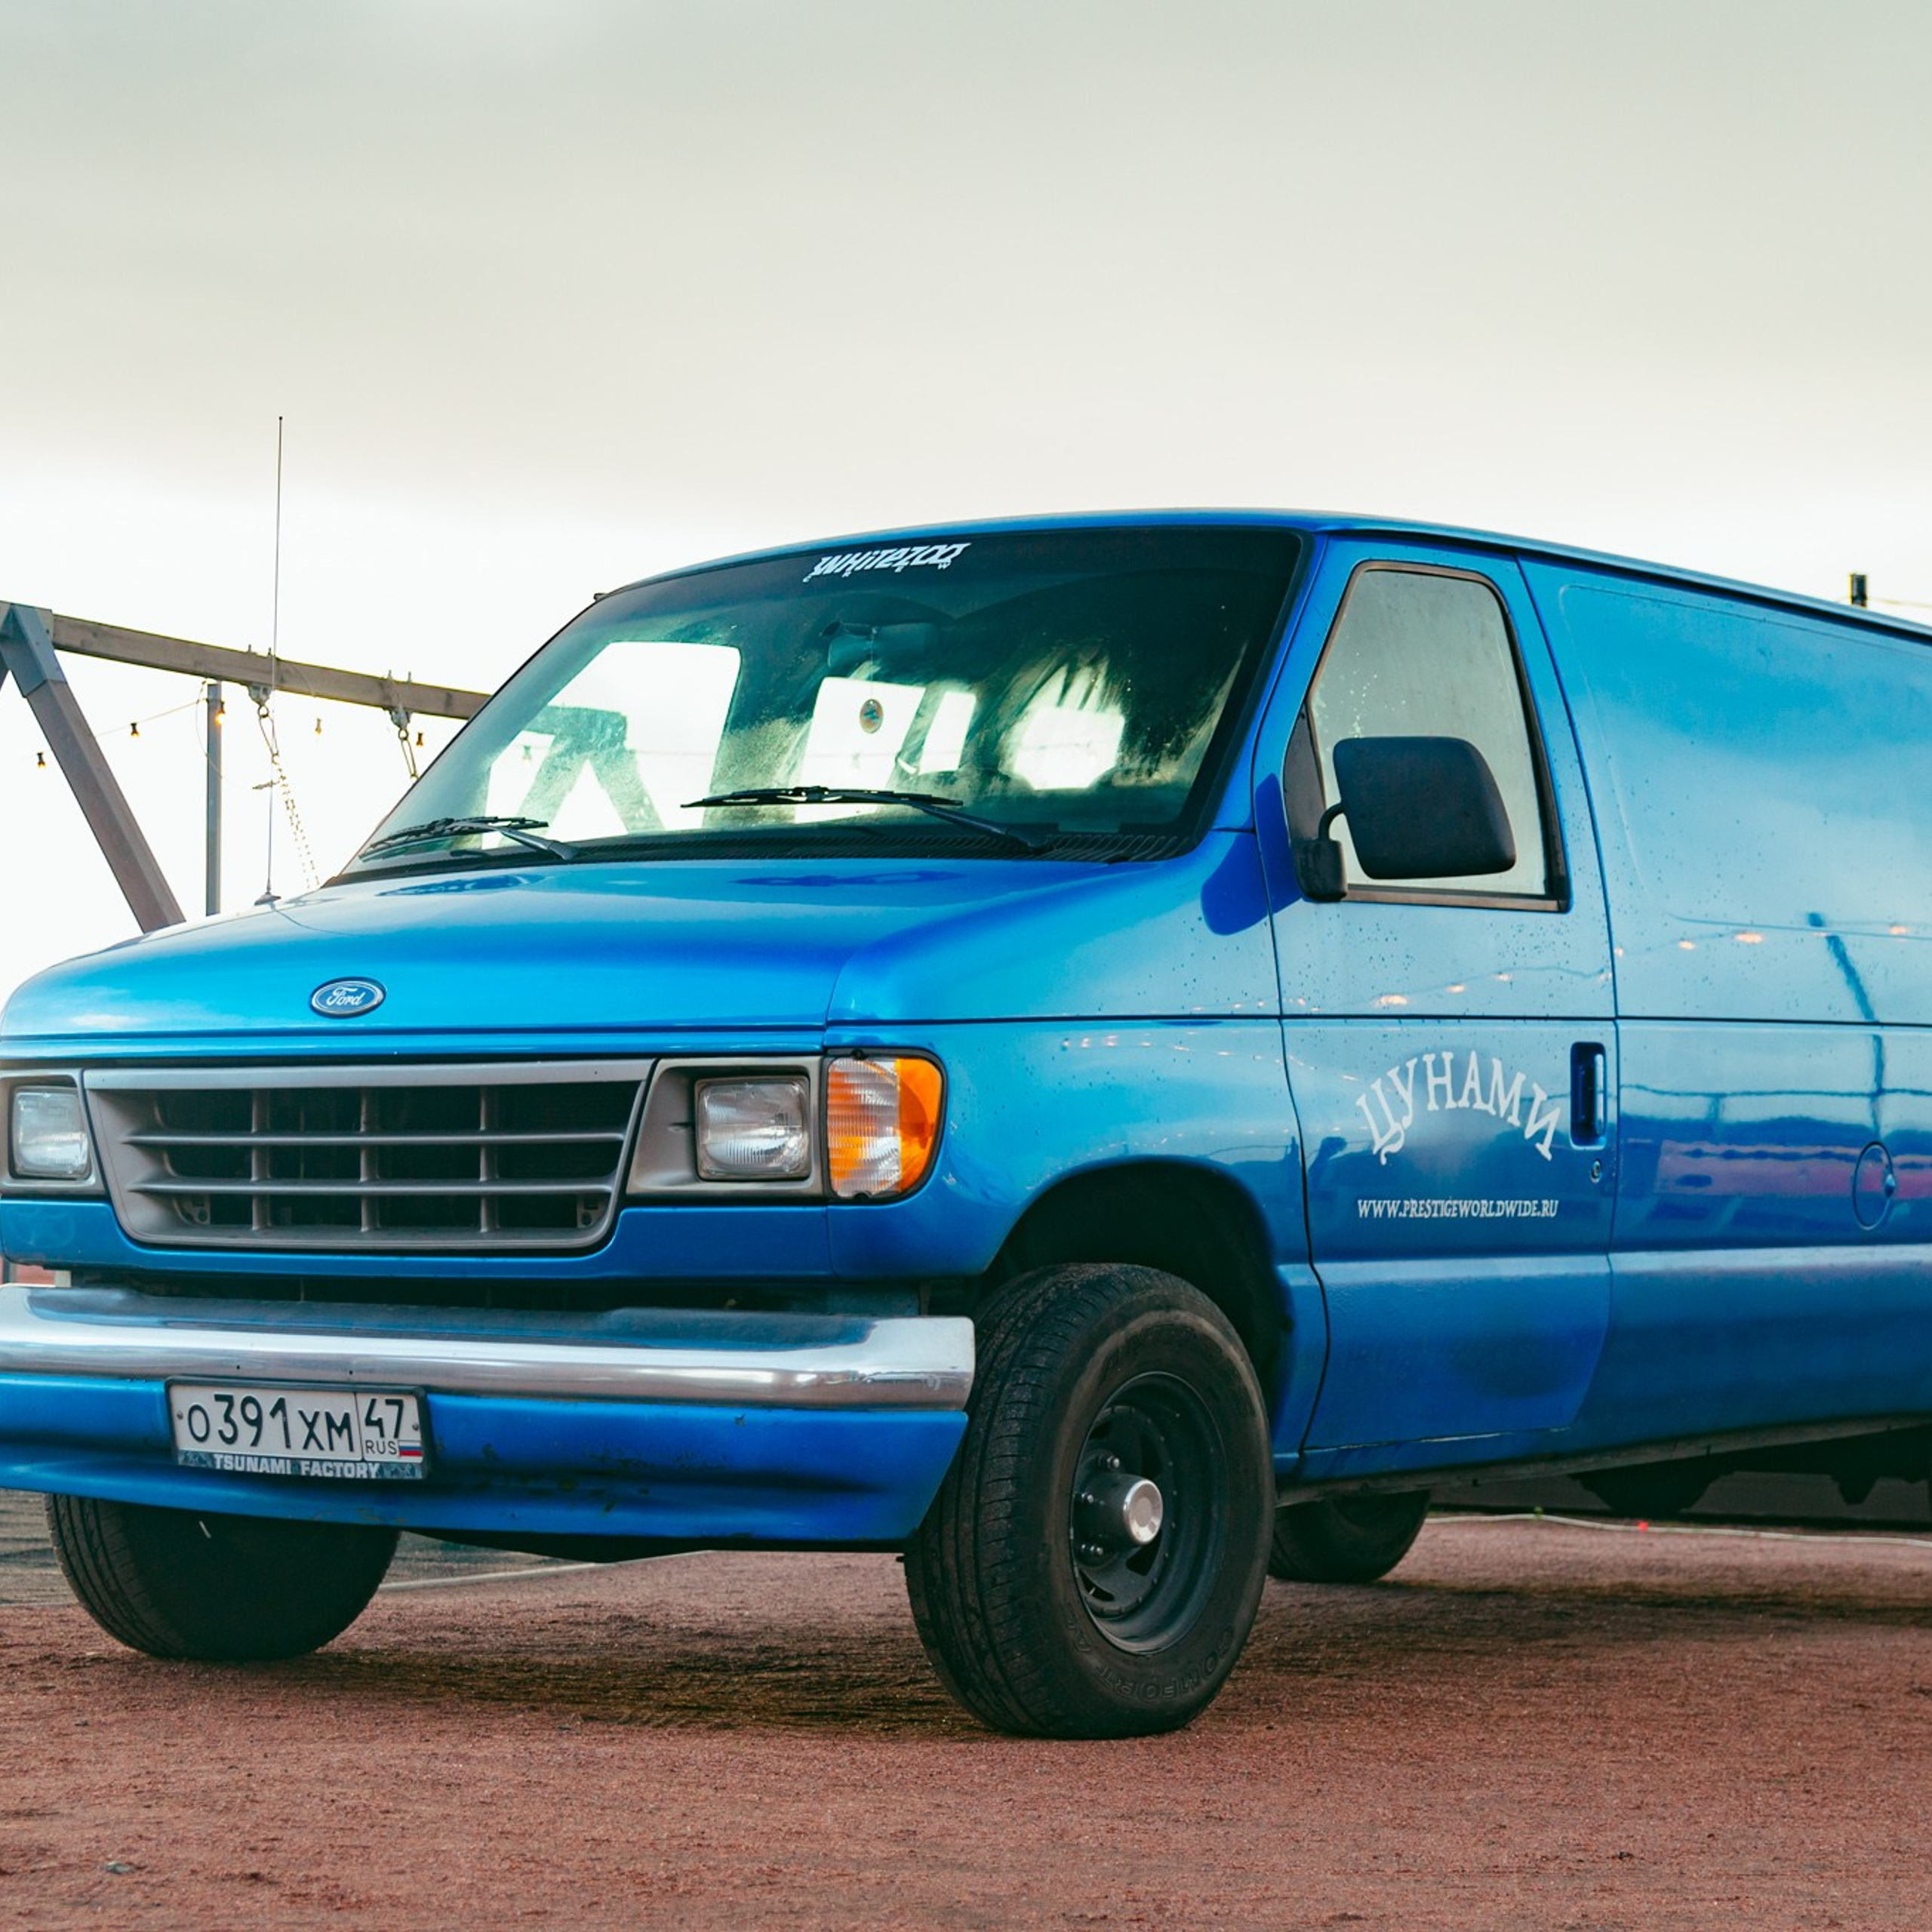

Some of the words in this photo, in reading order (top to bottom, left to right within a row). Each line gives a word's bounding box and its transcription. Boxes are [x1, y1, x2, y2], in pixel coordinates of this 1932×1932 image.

[326, 986, 366, 1006] Ford
[1356, 1050, 1561, 1166] ЦУНАМИ
[1357, 1198, 1559, 1219] WWW.PRESTIGEWORLDWIDE.RU
[365, 1398, 405, 1438] 47
[365, 1439, 398, 1455] RUS
[214, 1454, 292, 1475] TSUNAMI
[301, 1461, 381, 1479] FACTORY
